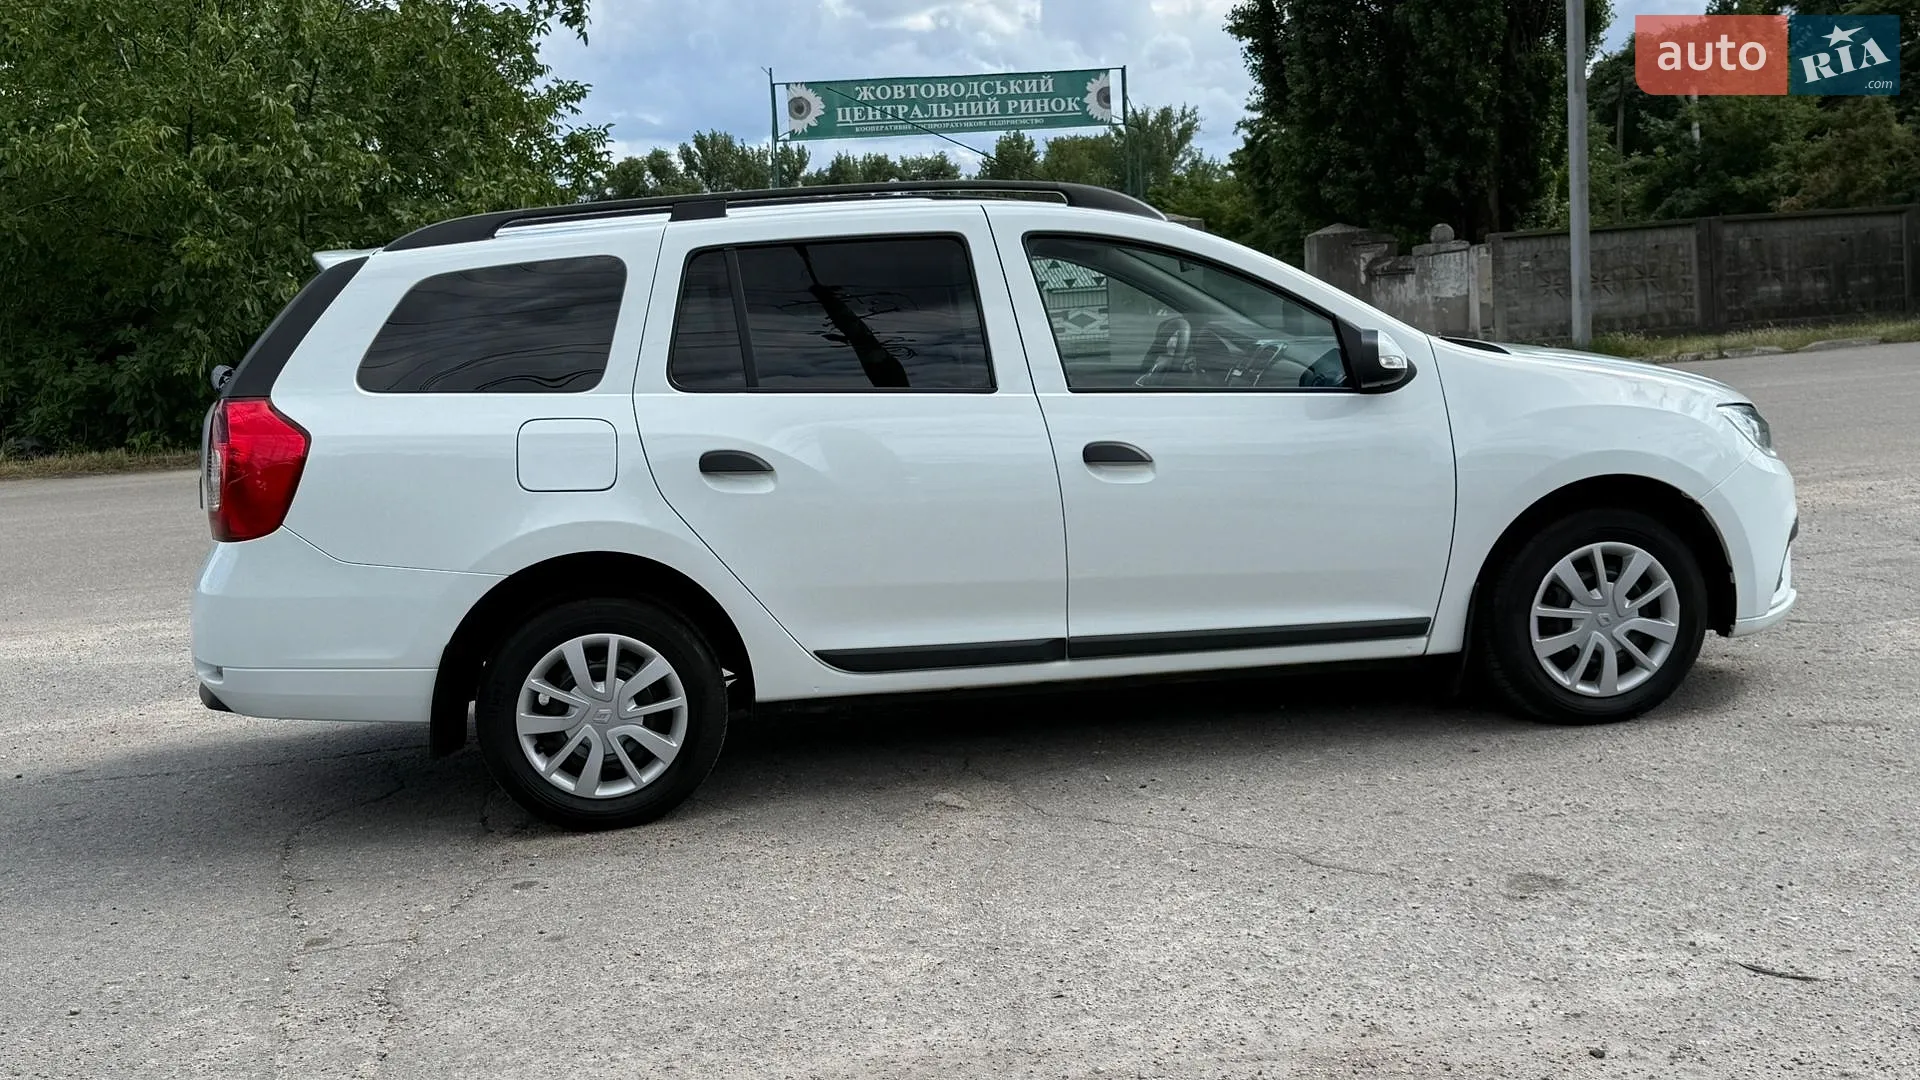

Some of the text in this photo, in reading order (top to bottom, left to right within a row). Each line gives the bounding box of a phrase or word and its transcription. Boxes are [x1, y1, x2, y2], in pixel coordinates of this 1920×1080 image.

[855, 75, 1054, 101] ЖОВТОВОДСЬКИЙ
[836, 96, 1081, 123] ЦЕНТРАЛЬНИЙ РИНОК
